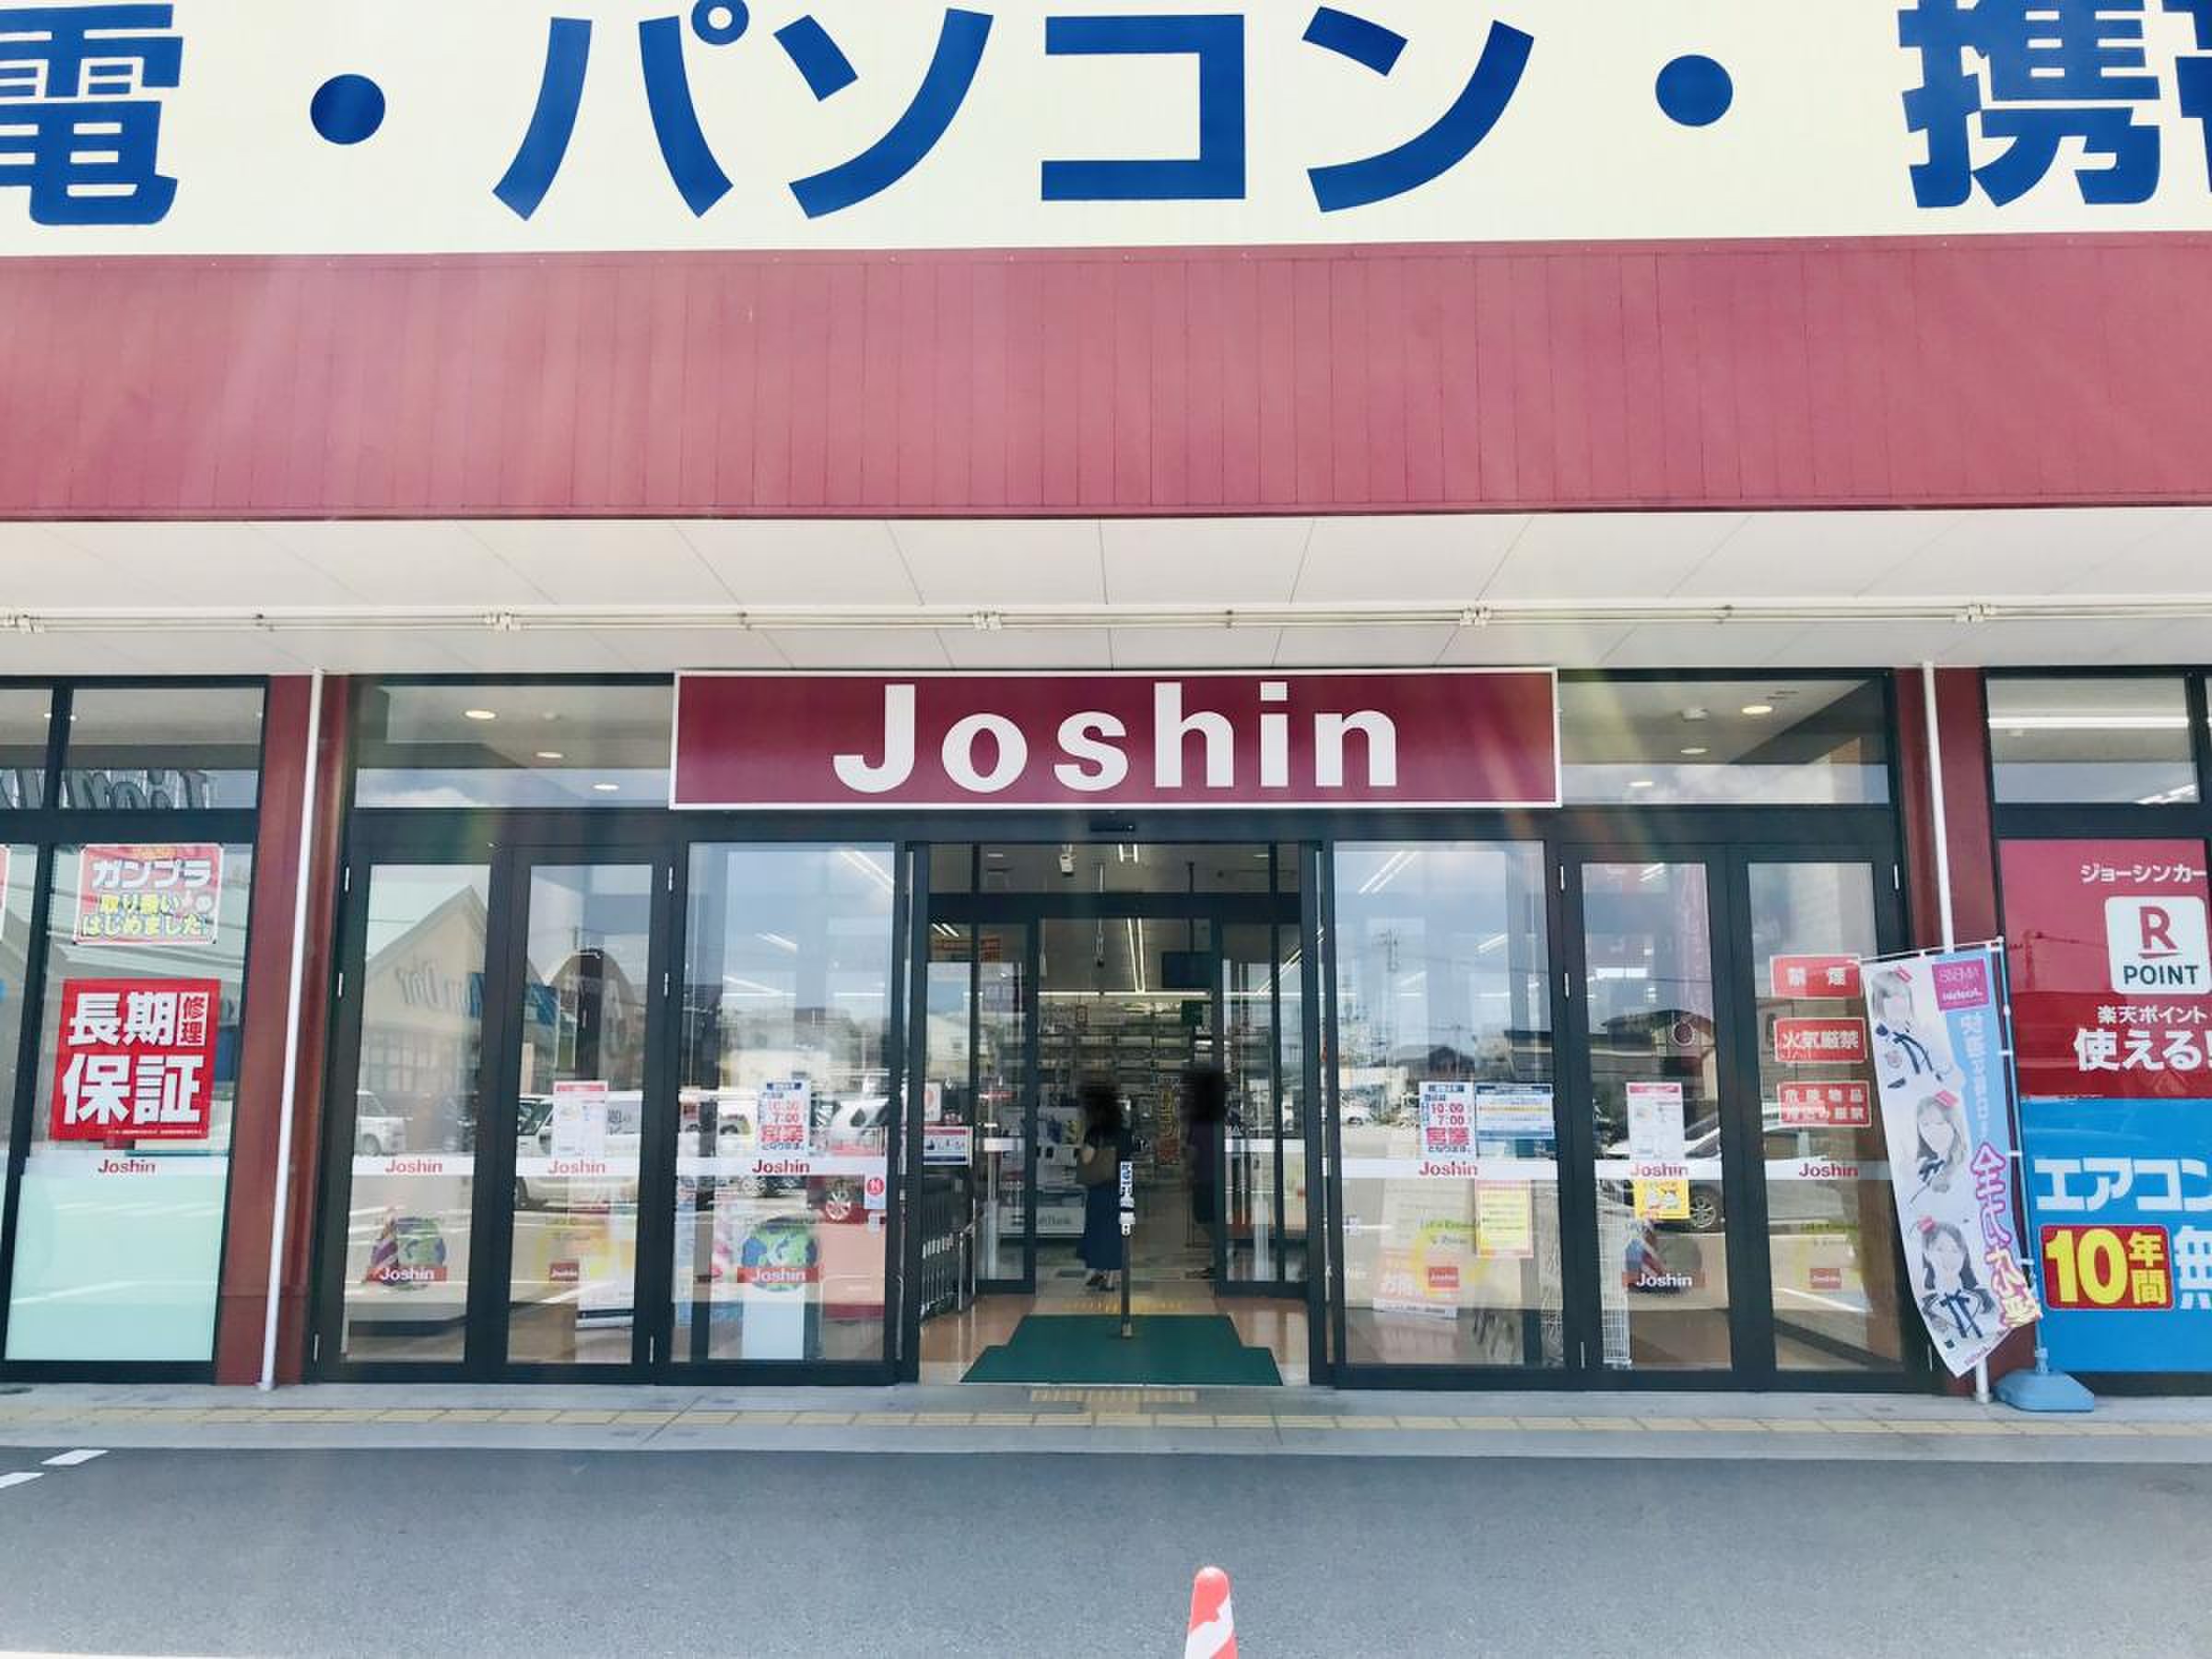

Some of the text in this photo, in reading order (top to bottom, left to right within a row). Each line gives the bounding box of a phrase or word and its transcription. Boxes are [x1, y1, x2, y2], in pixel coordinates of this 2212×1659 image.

[0, 0, 2212, 225] 電・パソコン・携
[833, 681, 1397, 793] Joshin
[93, 859, 210, 887] ガンプラ
[2080, 864, 2207, 883] ジョーシンカー
[2137, 906, 2178, 948] R
[2123, 965, 2199, 985] POINT
[67, 992, 178, 1046] 長期
[180, 995, 205, 1044] 修理
[2098, 1006, 2207, 1024] 楽天ポイント
[63, 1053, 204, 1124] 保証
[1431, 1103, 1465, 1113] 10:00
[1438, 1115, 1465, 1125] 7:00
[98, 1159, 156, 1173] Joshin
[384, 1159, 442, 1173] Joshin
[547, 1160, 606, 1175] Joshin
[752, 1159, 810, 1173] Joshin
[1419, 1161, 1477, 1176] Joshin
[1630, 1162, 1688, 1177] Joshin
[1799, 1162, 1858, 1177] Joshin
[2034, 1158, 2212, 1211] エアコン
[380, 1266, 435, 1280] Joshin
[2045, 1228, 2167, 1305] 10年間
[751, 1269, 806, 1281] Joshin
[1636, 1274, 1692, 1288] Joshin
